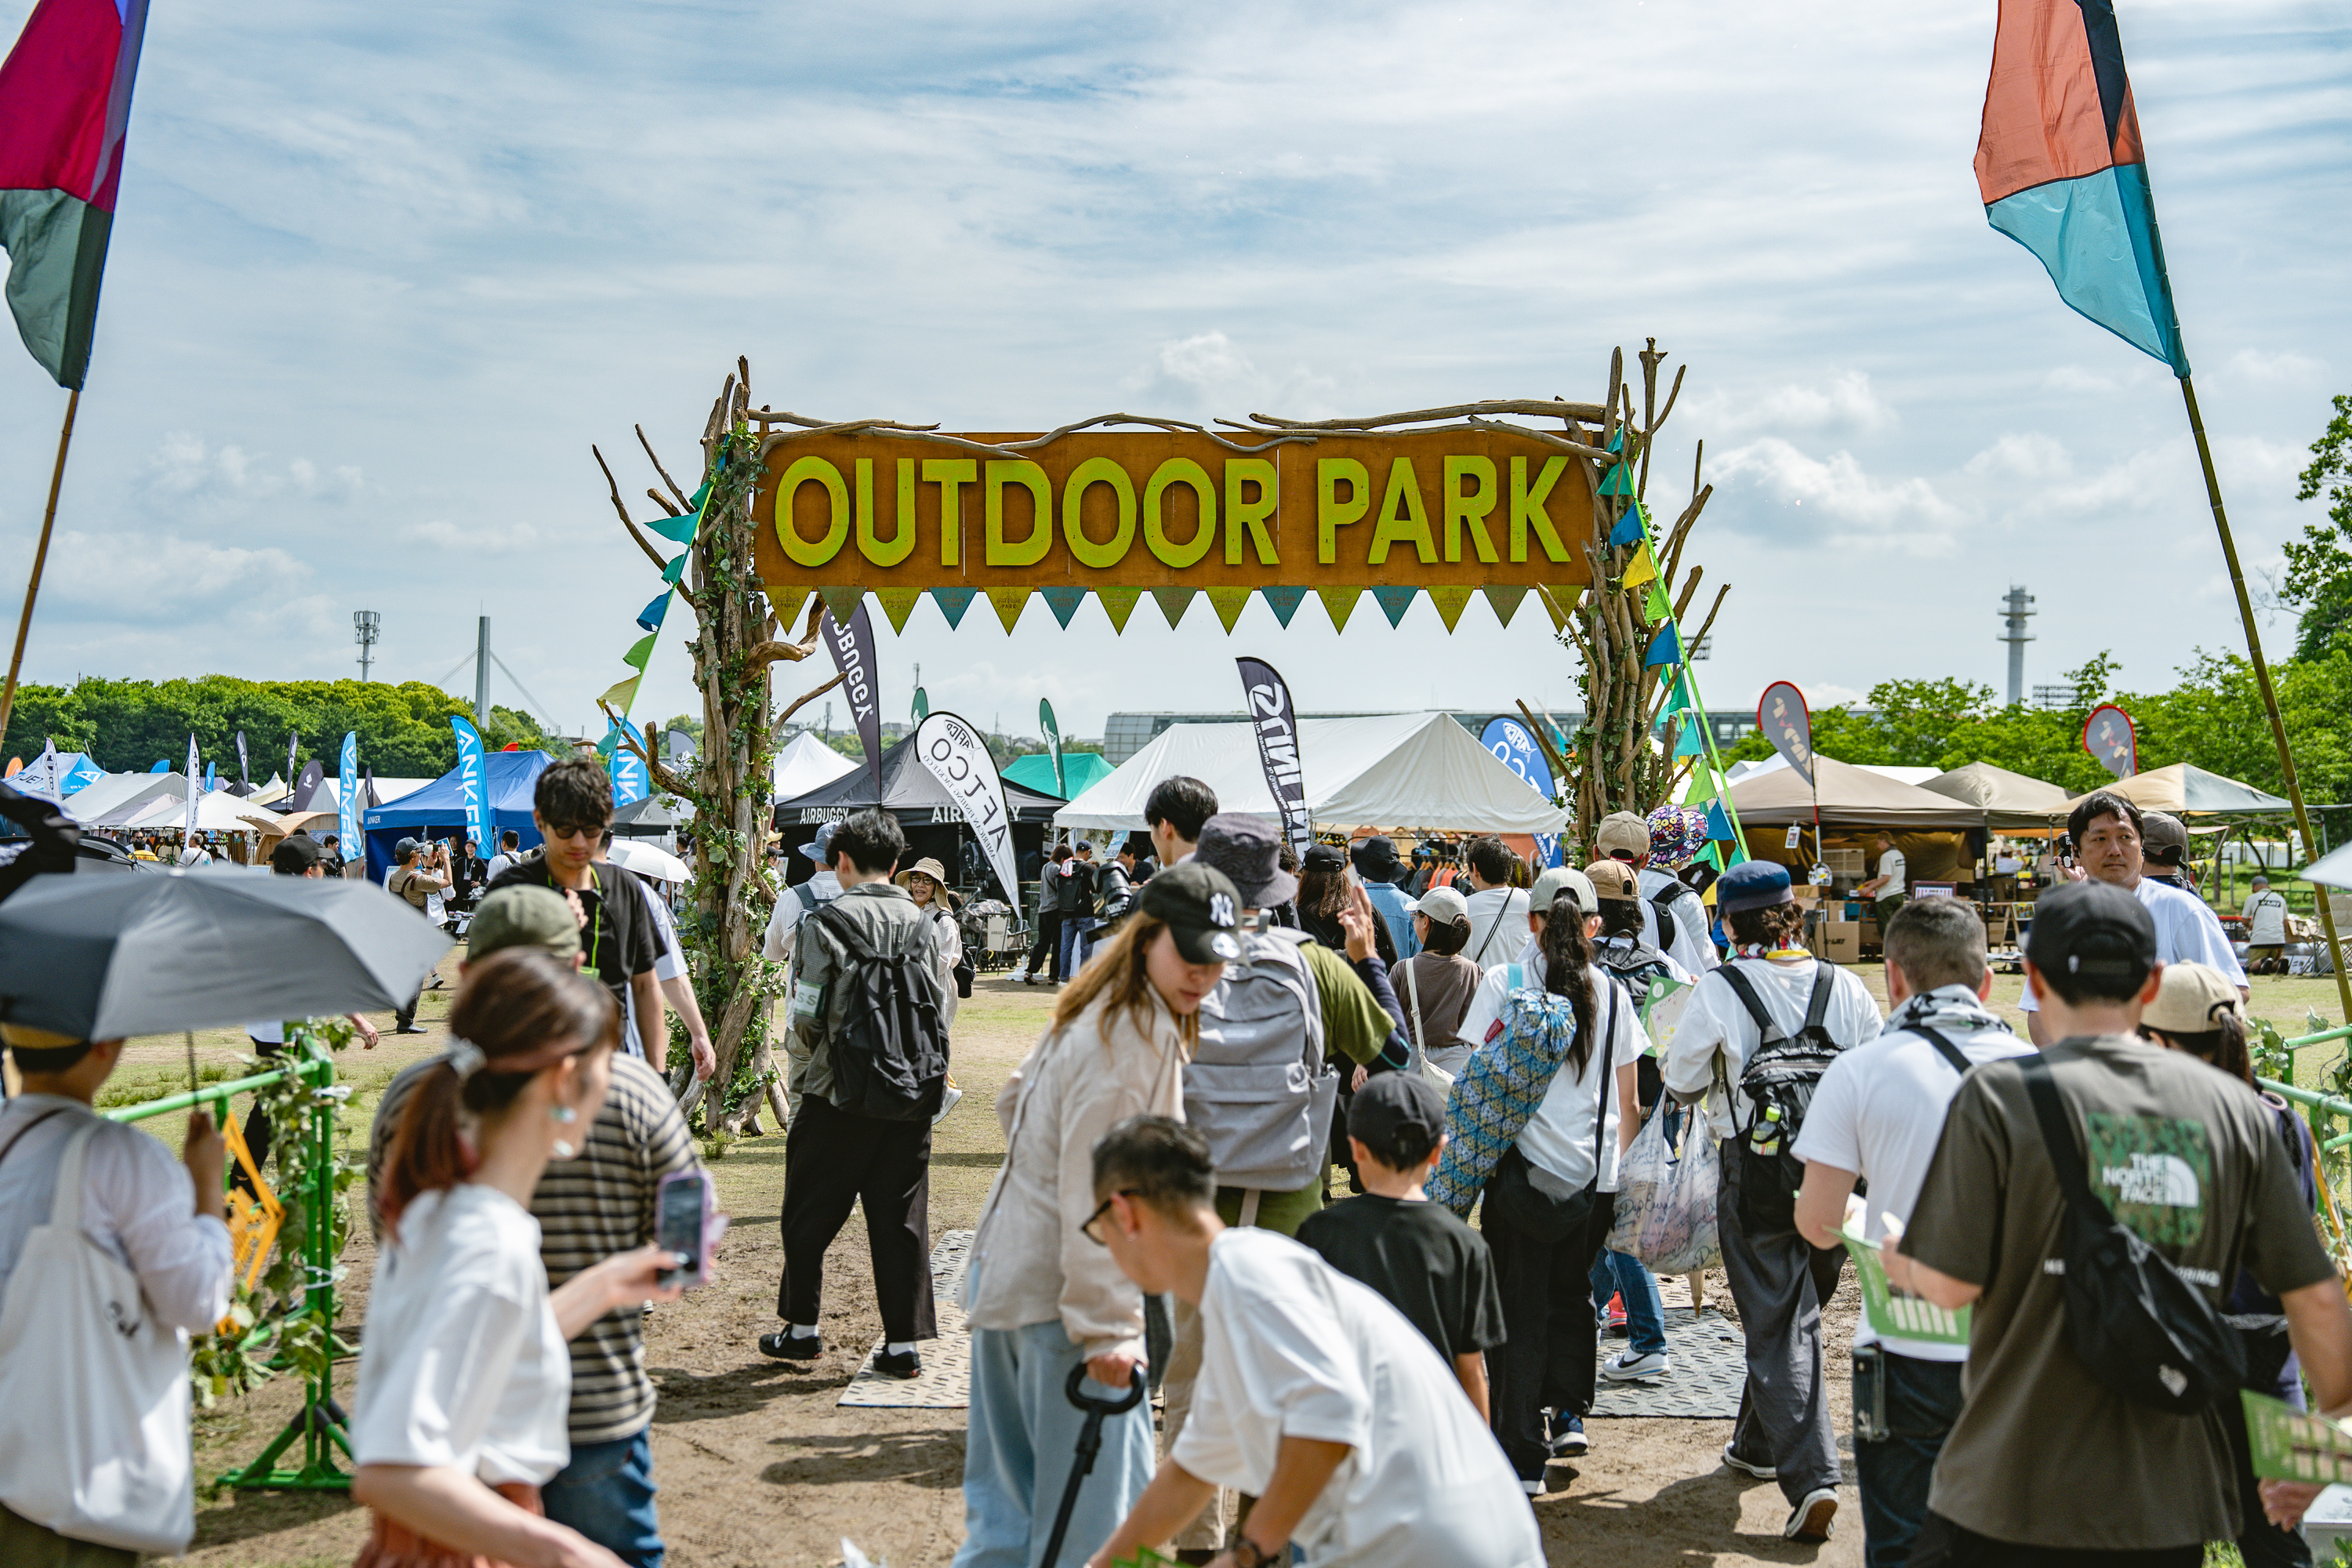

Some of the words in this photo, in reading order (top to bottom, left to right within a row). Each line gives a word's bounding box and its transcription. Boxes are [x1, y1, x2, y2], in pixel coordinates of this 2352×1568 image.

[775, 456, 1280, 568] OUTDOOR
[1318, 455, 1571, 564] PARK
[457, 729, 482, 844] ANKER
[800, 808, 849, 825] AIRBUGGY
[367, 815, 381, 825] ANKER
